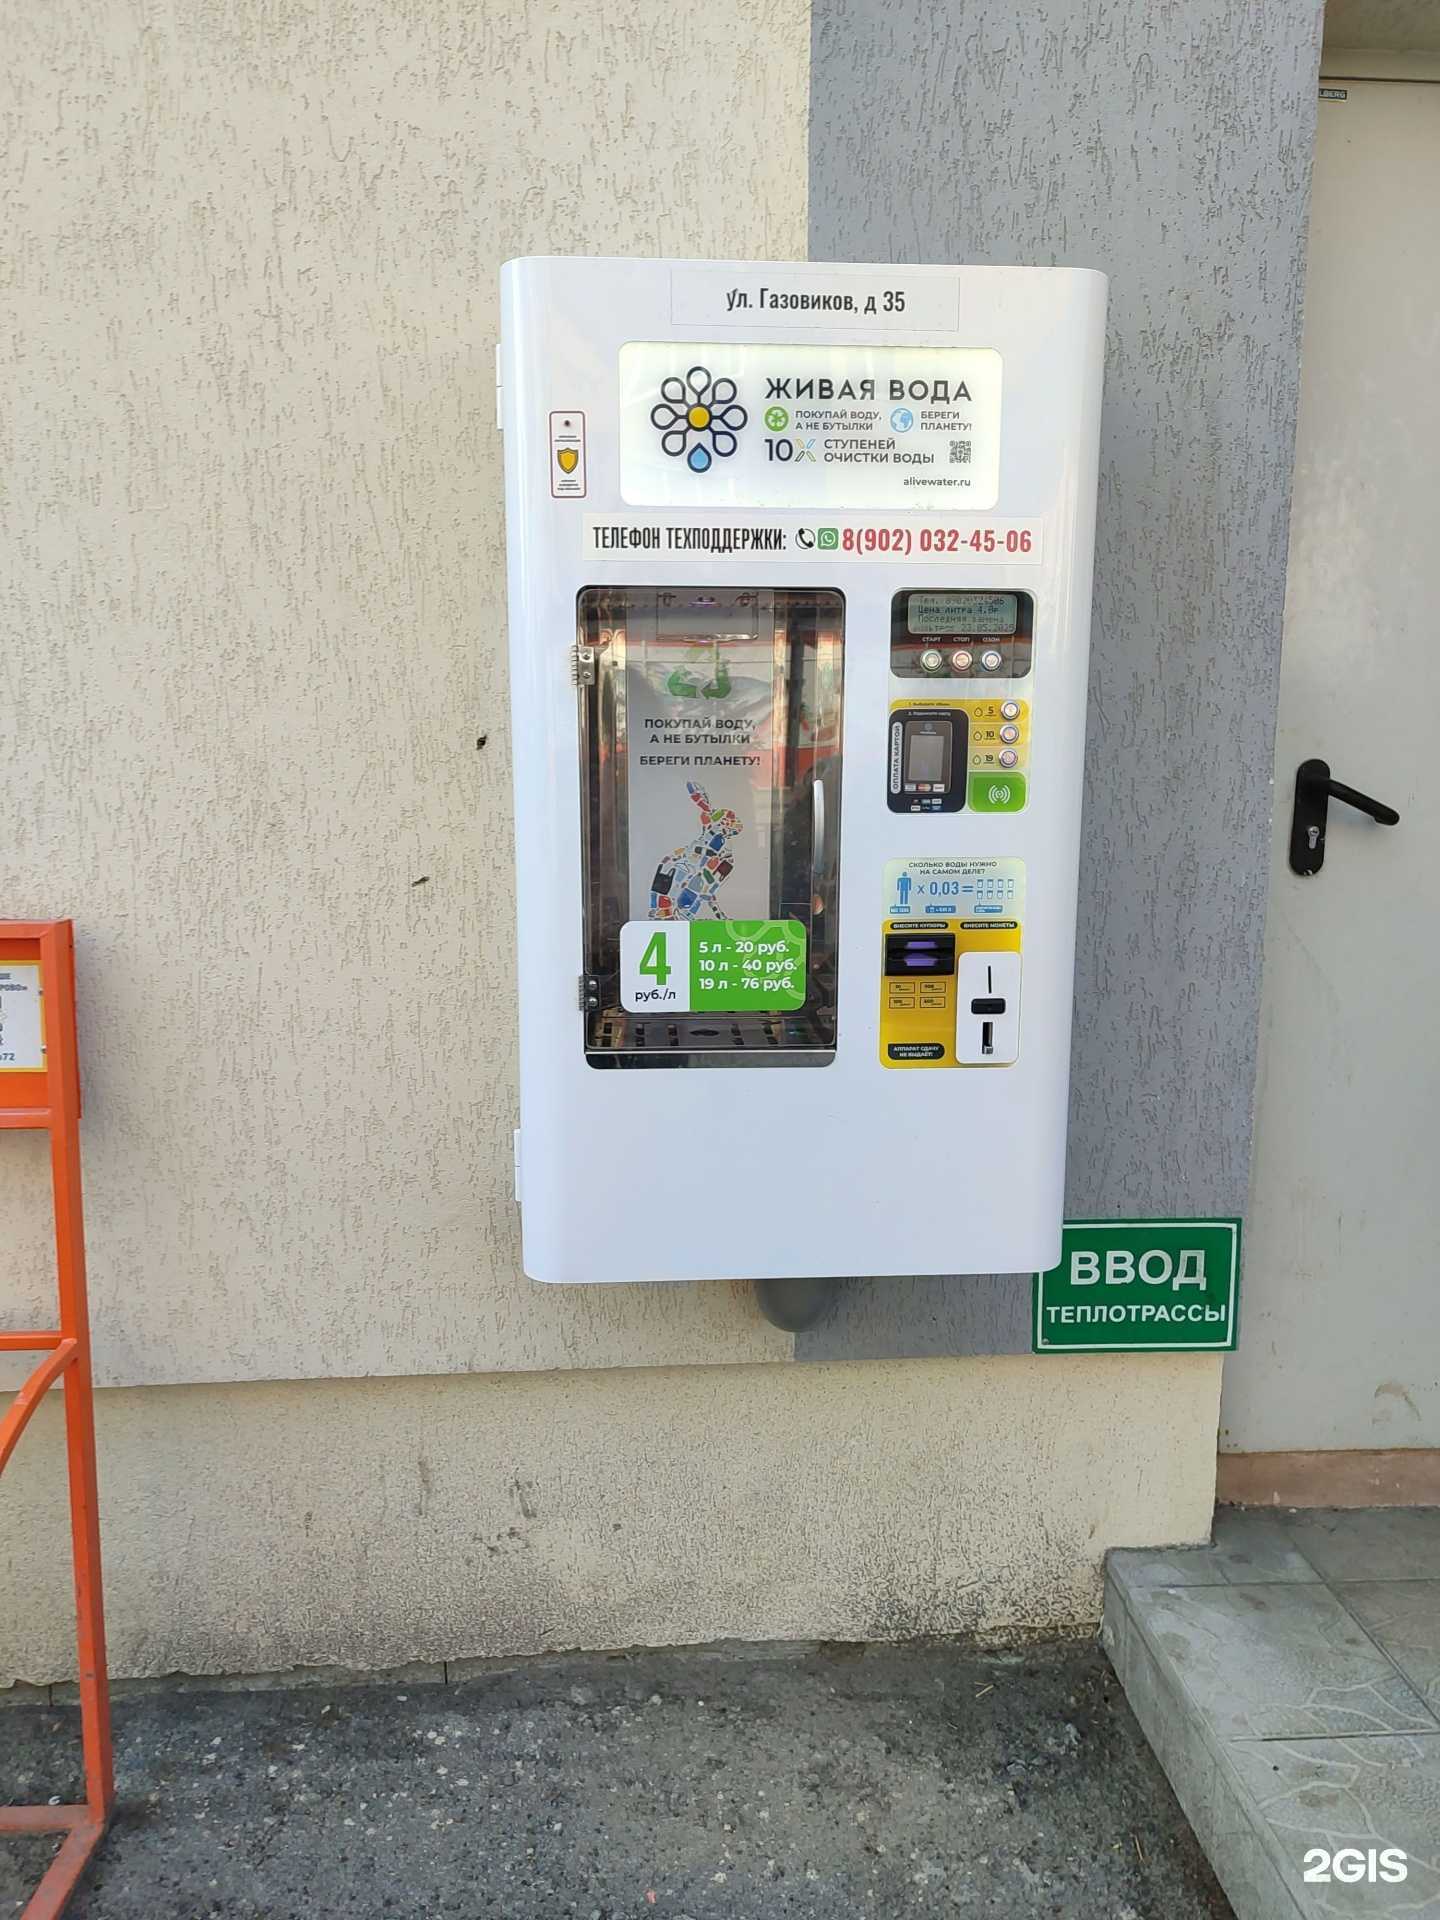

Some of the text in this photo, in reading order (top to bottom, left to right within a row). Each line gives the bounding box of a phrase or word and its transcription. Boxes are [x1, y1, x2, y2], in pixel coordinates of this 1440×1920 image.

[726, 288, 905, 314] ул. Газовиков, д 35
[765, 378, 972, 404] ЖИВАЯ ВОДА
[795, 409, 882, 420] ПОКУПАЙ ВОДУ,
[920, 411, 960, 420] БЕРЕГИ
[795, 422, 873, 431] А НЕ БУТЫЛКИ
[920, 422, 972, 432] ПЛАНЕТУ!
[824, 437, 896, 450] СТУПЕНЕЙ
[824, 452, 935, 465] ОЧИСТКИ ВОДЫ
[903, 476, 971, 487] alivewater.ru
[593, 526, 1032, 555] ТЕЛЕФОН ТЕХПОДДЕРЖКИ: 8(902) 032-45-06
[918, 606, 940, 614] Цена
[644, 717, 756, 731] ПОКУПАЙ ВОДУ,
[650, 735, 750, 744] А НЕ БУТЫЛКИ
[640, 756, 760, 766] БЕРЕГИ ПЛАНЕТУ!
[892, 725, 902, 791] ОПЛАТА КАРТОЙ
[929, 881, 959, 896] 0,03
[699, 941, 708, 953] 5
[712, 944, 722, 953] л
[735, 942, 754, 953] 20
[758, 940, 790, 956] руб.
[639, 931, 672, 985] 4
[699, 960, 714, 971] 10
[719, 961, 729, 971] л
[742, 960, 762, 971] 40
[766, 959, 797, 974] руб.
[699, 978, 714, 989] 19
[717, 981, 727, 990] л
[741, 979, 759, 989] 76
[763, 977, 795, 993] руб.
[635, 988, 676, 1002] руб./л
[1070, 1250, 1207, 1291] ВВОД
[1046, 1304, 1226, 1324] ТЕПЛОТРАССЫ
